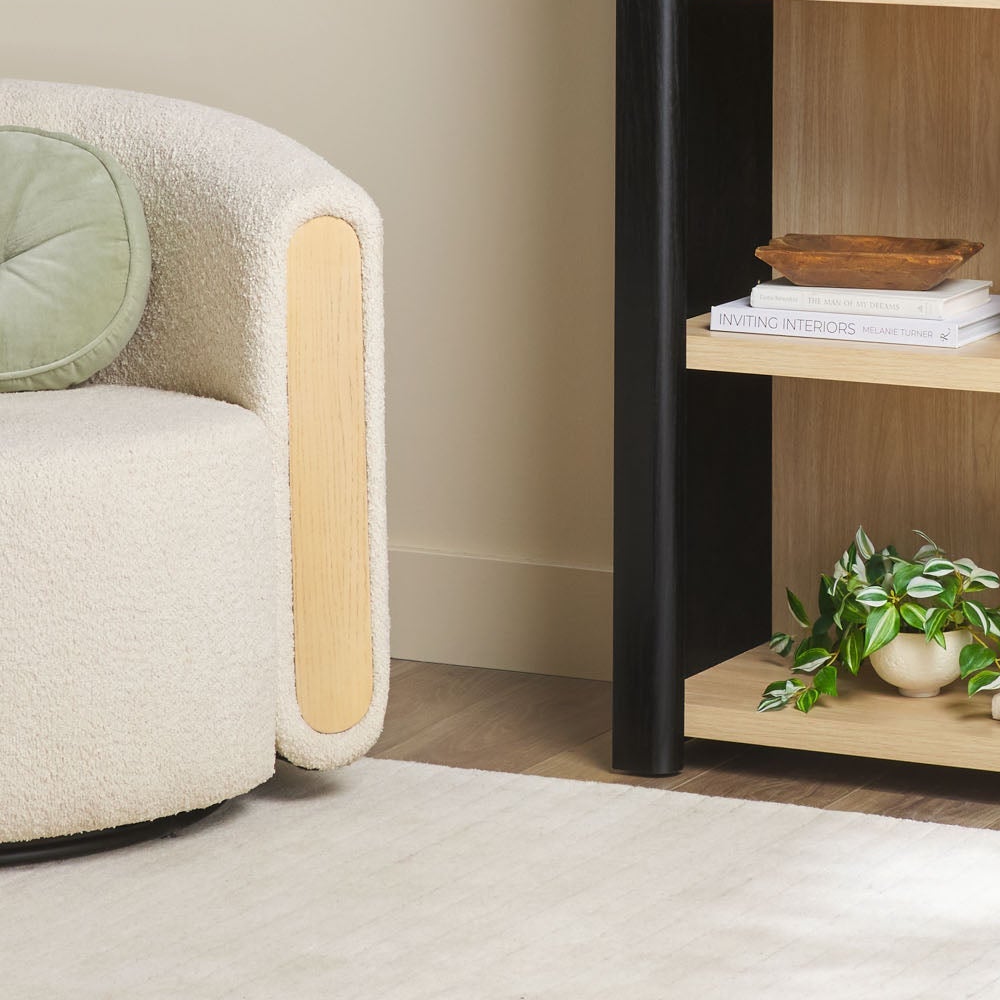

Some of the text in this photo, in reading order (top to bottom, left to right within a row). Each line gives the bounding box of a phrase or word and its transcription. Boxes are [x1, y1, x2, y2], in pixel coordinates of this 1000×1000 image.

[808, 297, 821, 305] THE
[824, 298, 841, 306] MAN
[869, 301, 901, 310] DREAMS
[719, 313, 933, 338] INVITING INTERIORS MELANIE TURNER
